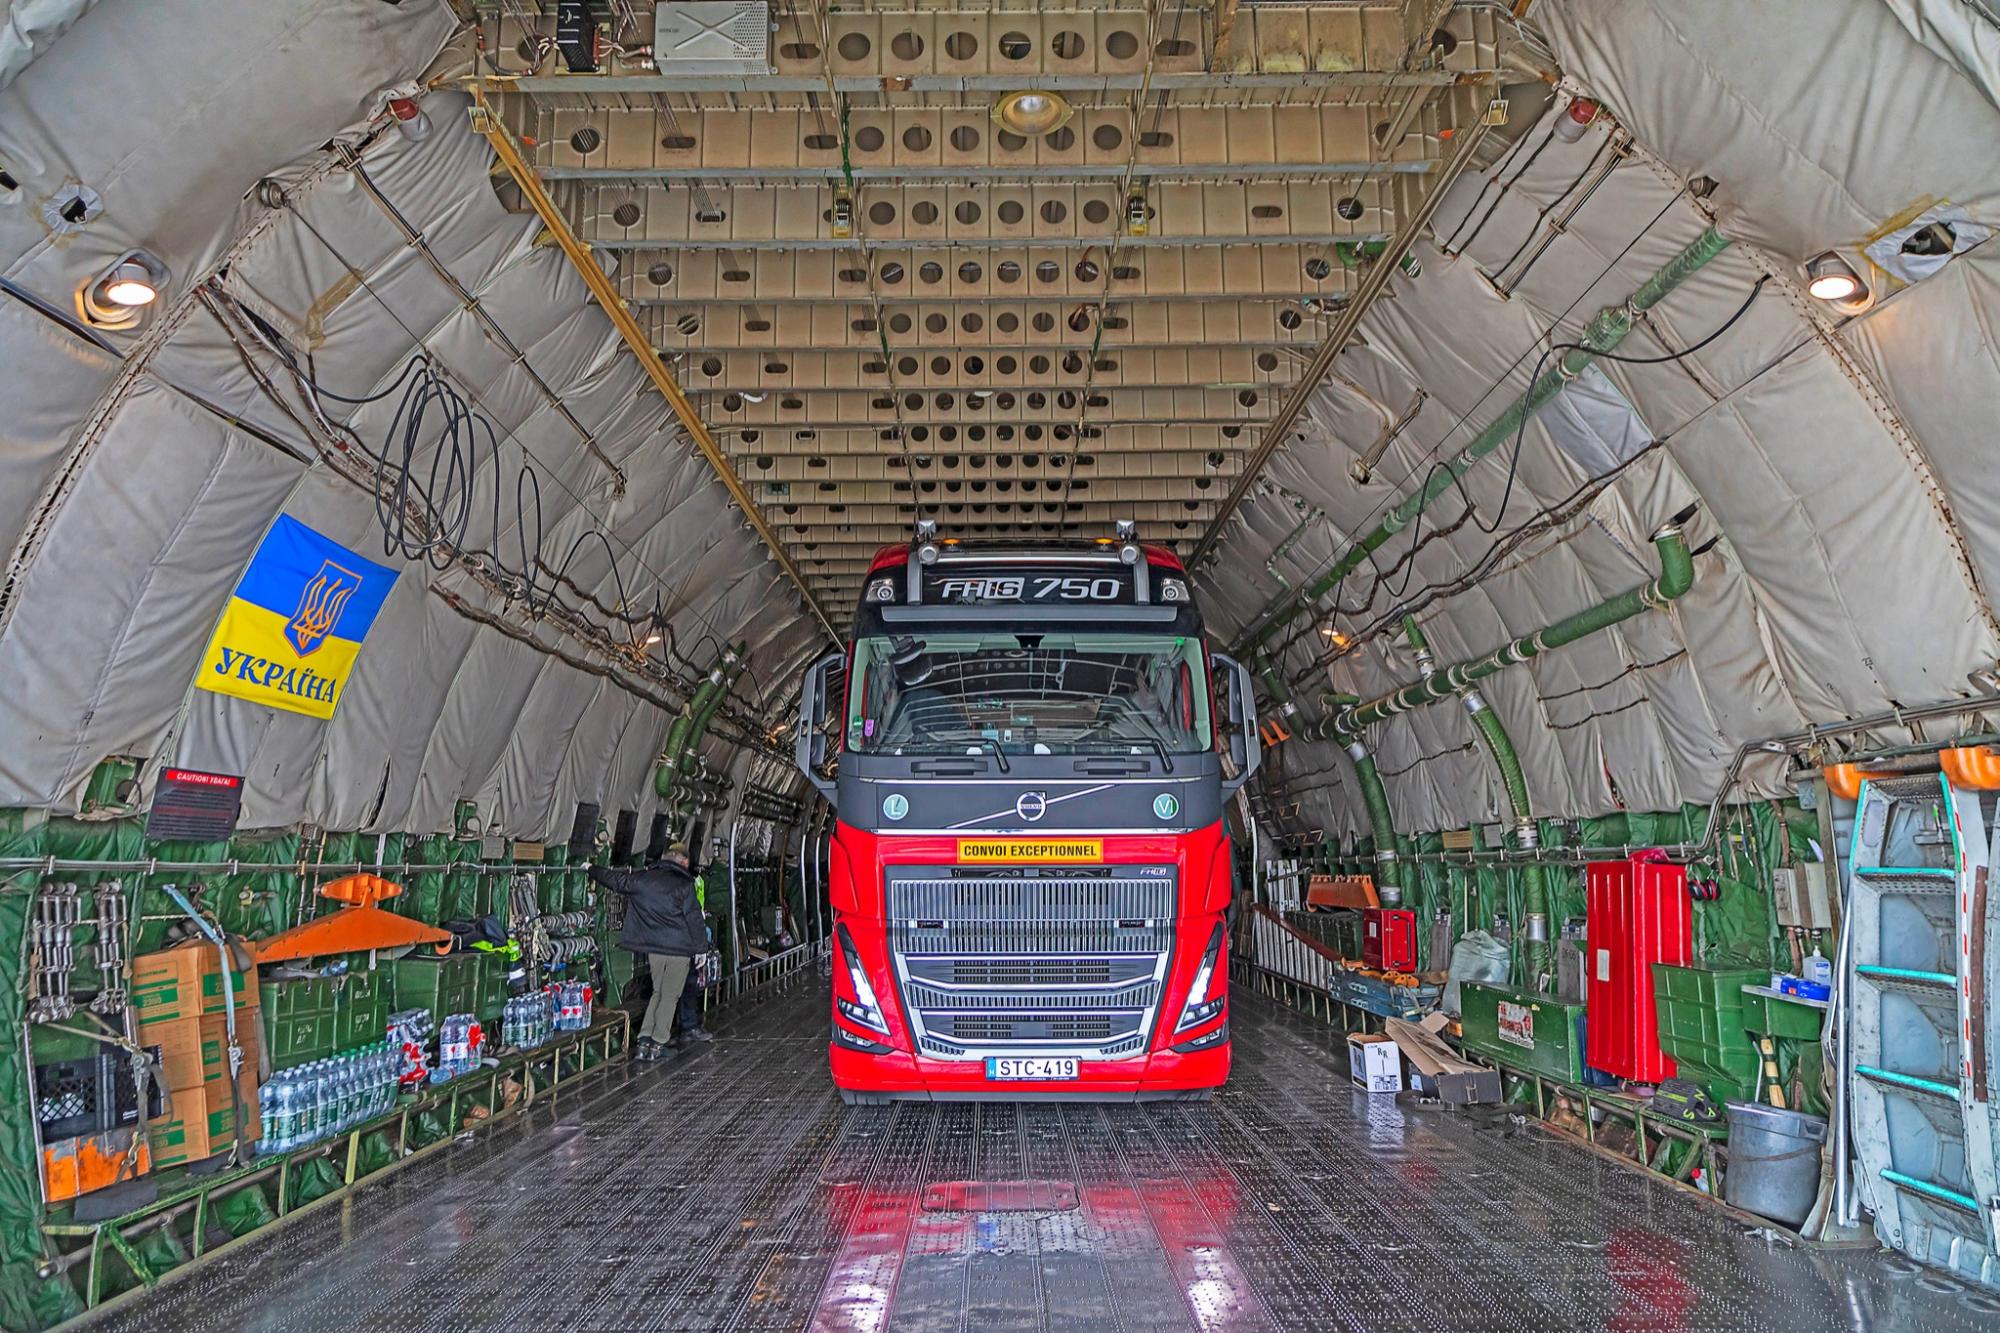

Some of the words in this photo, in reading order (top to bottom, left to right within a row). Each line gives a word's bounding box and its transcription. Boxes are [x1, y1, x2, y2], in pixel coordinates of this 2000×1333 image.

[1032, 577, 1120, 599] 750
[215, 646, 337, 703] УКРАЇНА
[964, 845, 1007, 857] CONVOI
[1011, 845, 1097, 857] EXCEPTIONNEL
[1000, 1060, 1074, 1076] STC-419
